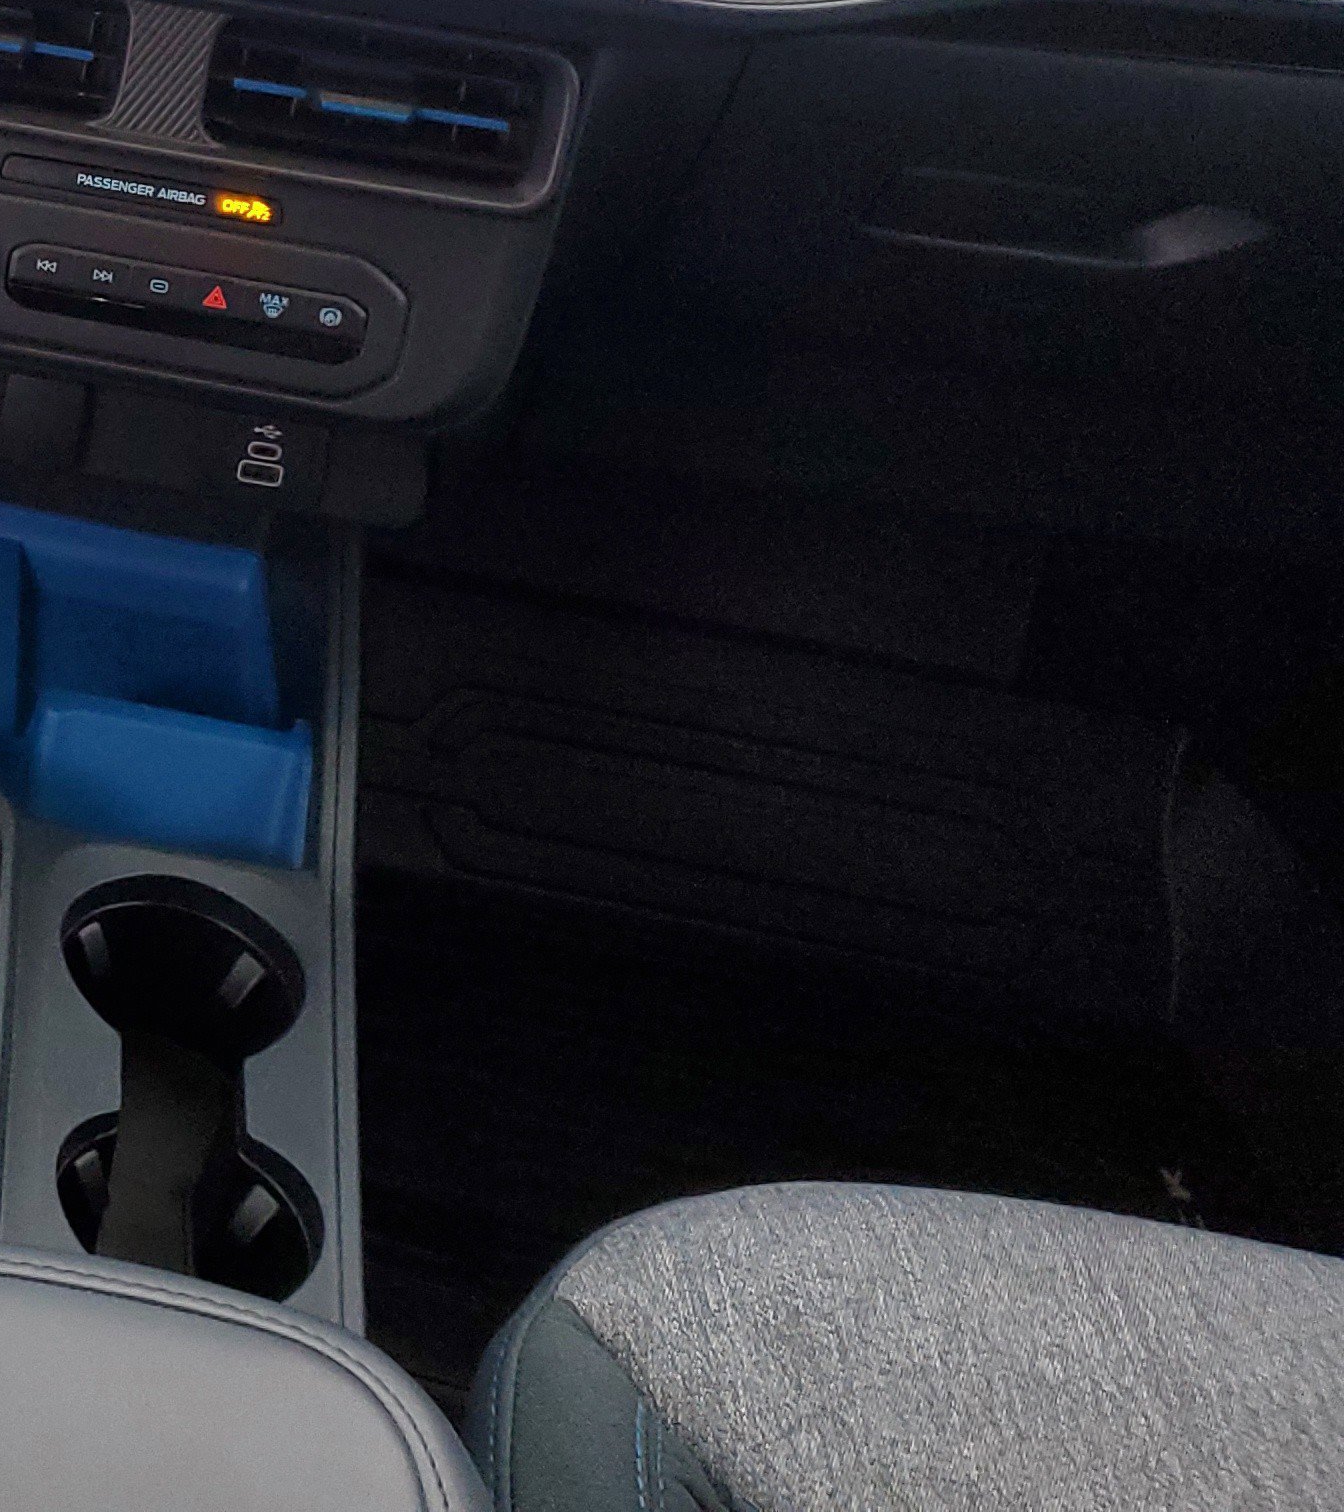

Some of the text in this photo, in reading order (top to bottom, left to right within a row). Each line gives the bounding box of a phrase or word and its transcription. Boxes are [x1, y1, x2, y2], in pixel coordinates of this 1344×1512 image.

[76, 173, 250, 215] PASSENGER AIRBAG OFF
[259, 292, 290, 308] MAX
